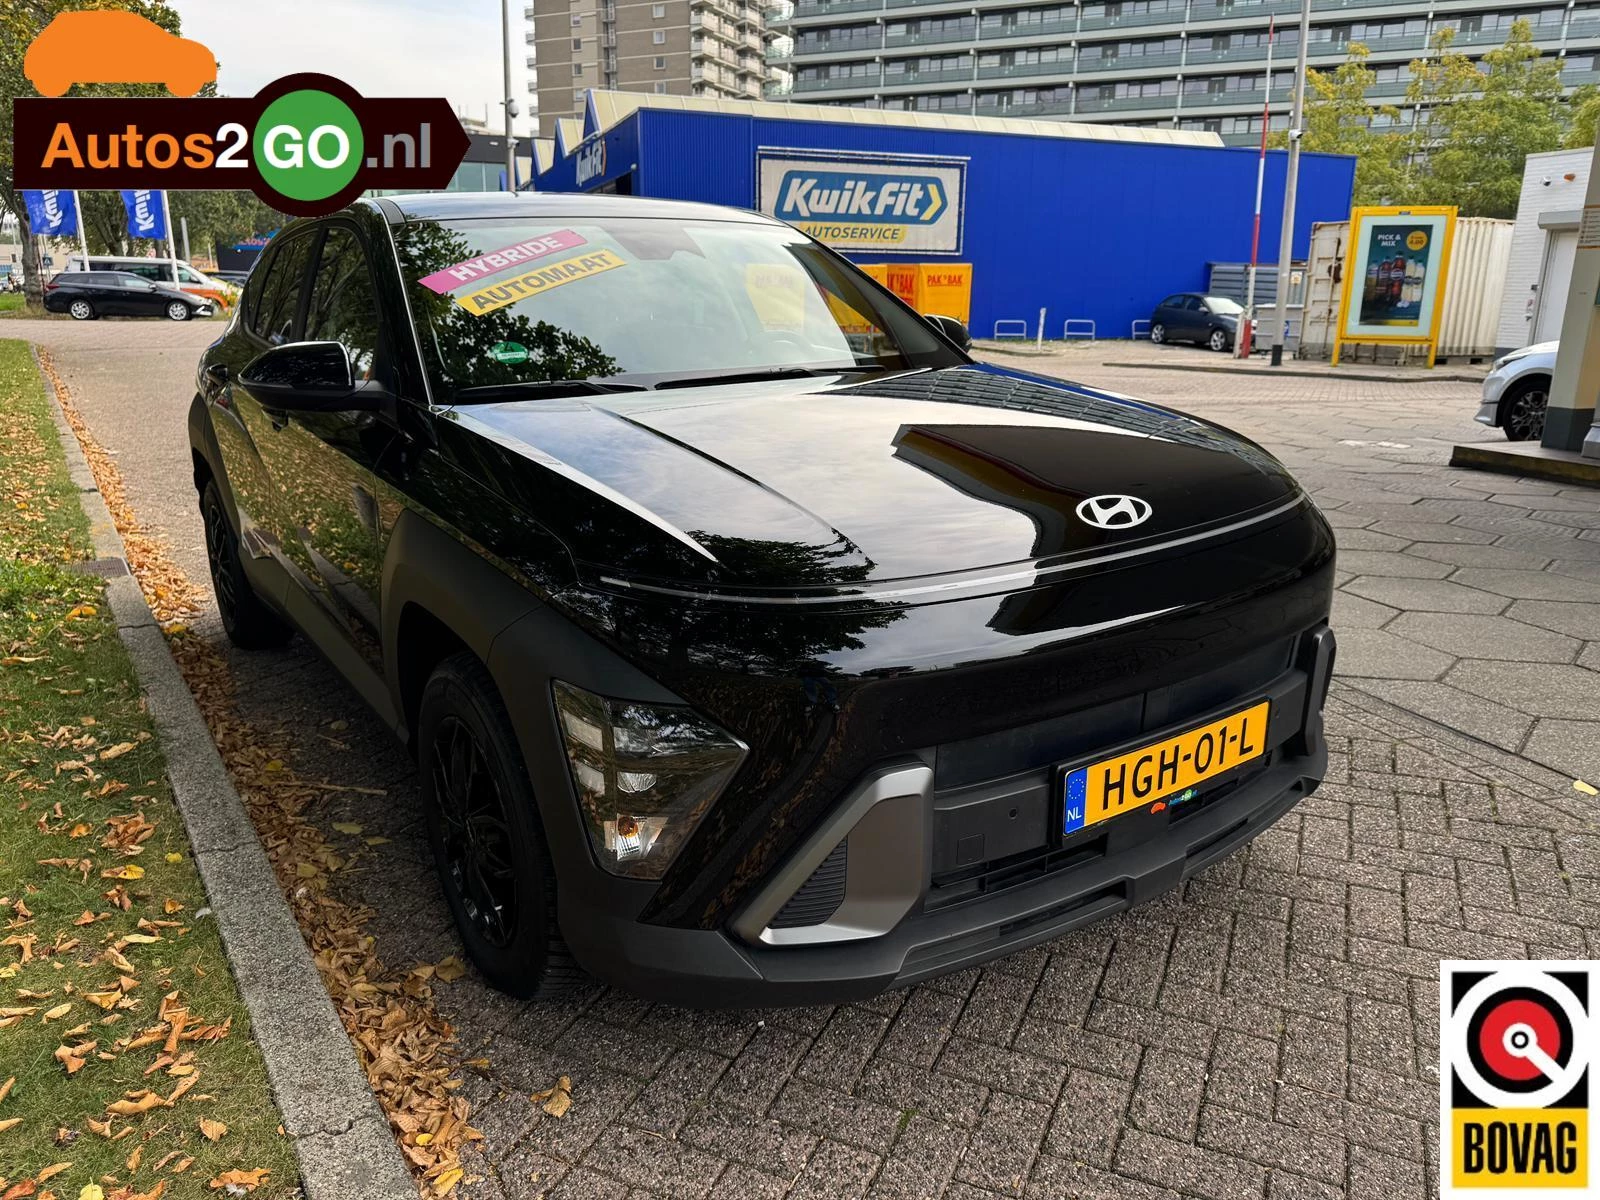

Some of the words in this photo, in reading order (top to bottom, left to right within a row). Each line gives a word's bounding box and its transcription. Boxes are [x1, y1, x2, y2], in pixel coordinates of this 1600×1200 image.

[804, 225, 901, 240] AUTOSERVICE
[448, 236, 564, 282] HYBRIDE
[471, 252, 614, 310] AUTOMAAT
[1102, 717, 1254, 811] HGH-01-L
[1066, 806, 1082, 823] NL
